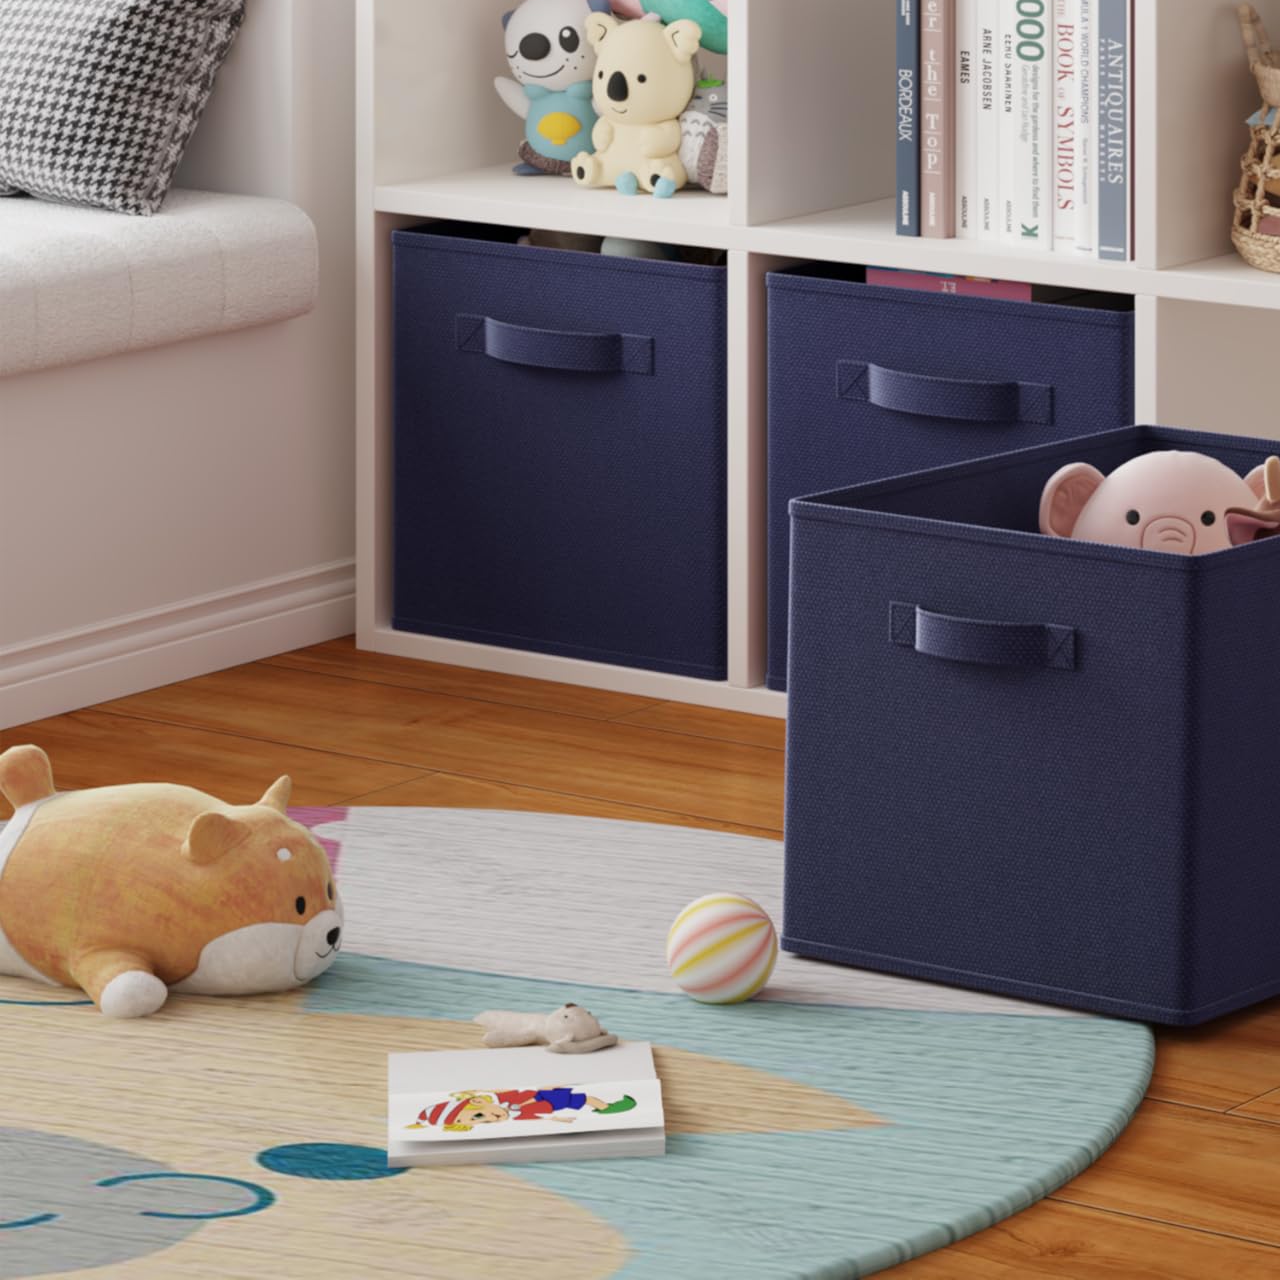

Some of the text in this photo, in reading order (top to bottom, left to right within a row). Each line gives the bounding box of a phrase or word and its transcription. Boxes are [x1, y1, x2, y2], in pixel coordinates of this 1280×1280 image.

[925, 49, 939, 98] the
[960, 51, 970, 84] EAMES
[982, 28, 992, 110] ARNE JACOBSEN
[1057, 24, 1074, 81] BOOK
[1080, 33, 1089, 67] WORLD
[898, 69, 913, 143] BORDEAUX
[1032, 102, 1041, 113] the
[1080, 69, 1089, 124] CHAMPIONS
[1105, 38, 1124, 184] ANTIQUAIRES
[925, 113, 939, 170] Top
[1032, 142, 1041, 156] and
[1057, 105, 1074, 211] SYMBOLS
[1032, 186, 1041, 200] find
